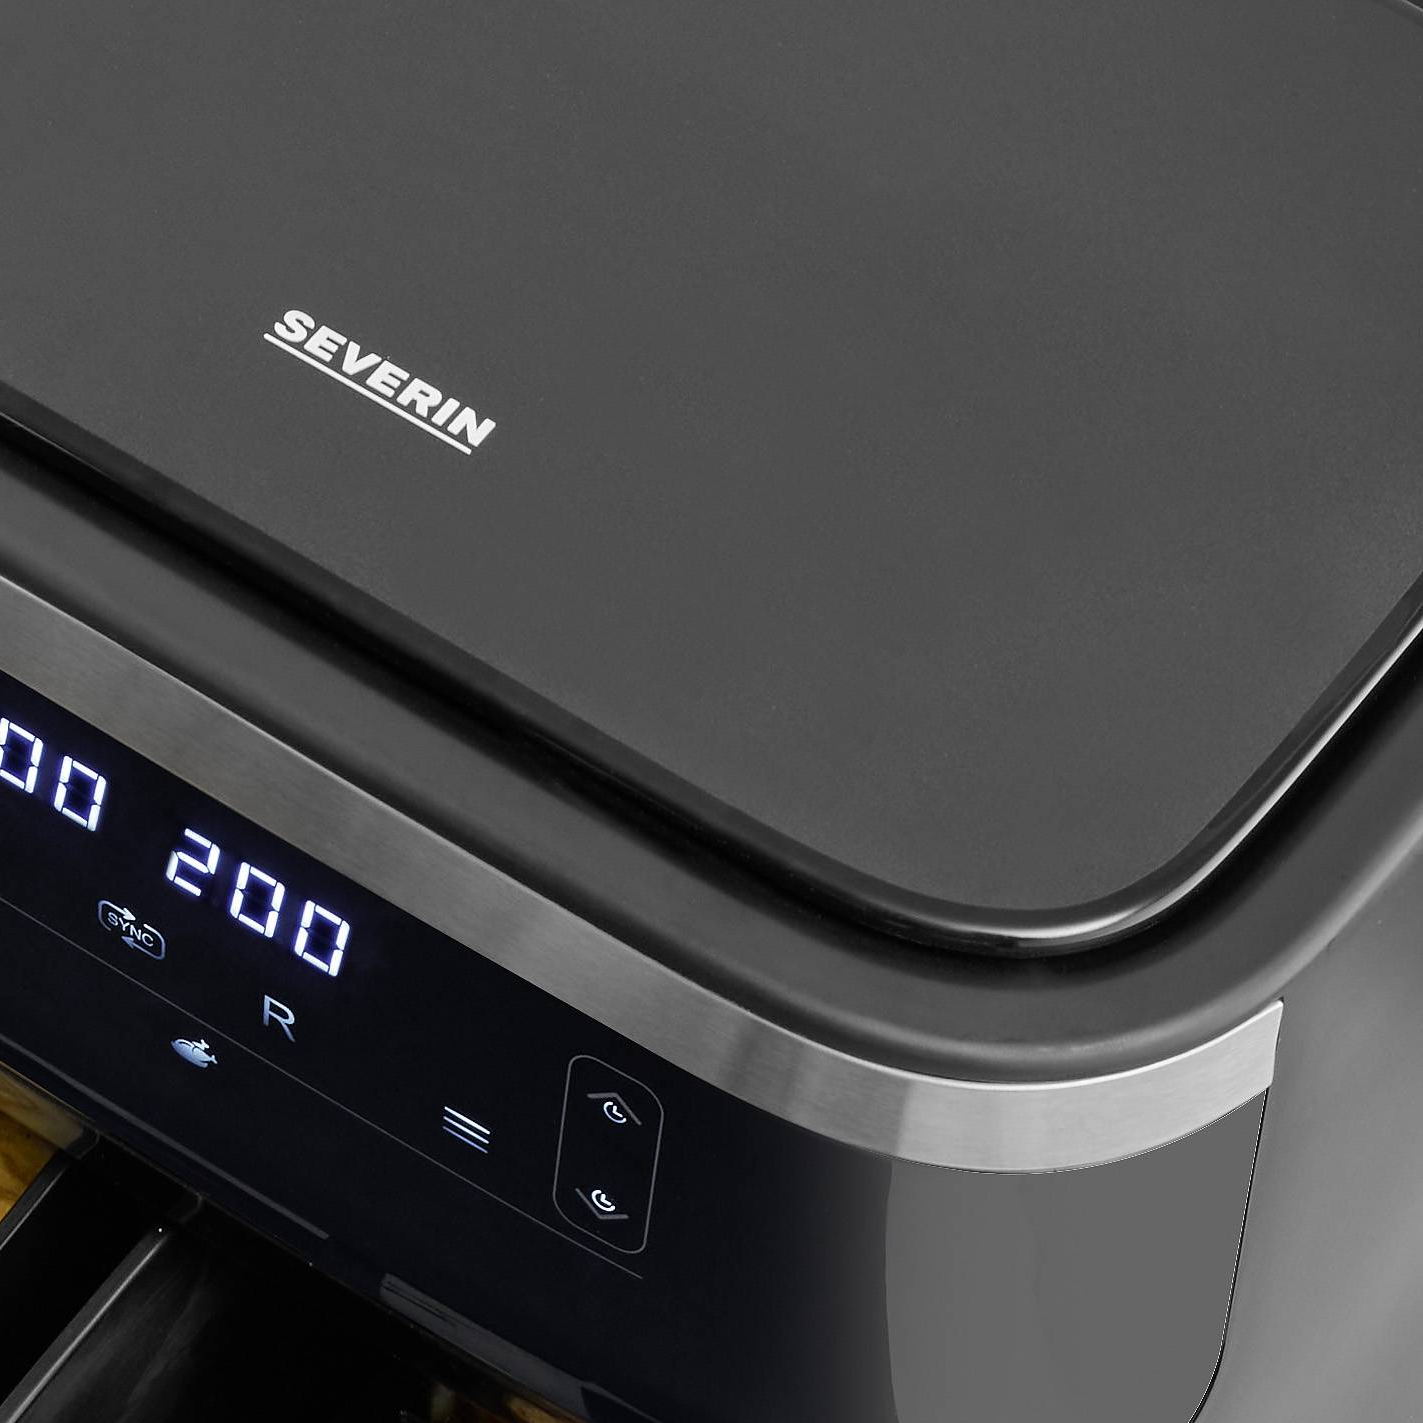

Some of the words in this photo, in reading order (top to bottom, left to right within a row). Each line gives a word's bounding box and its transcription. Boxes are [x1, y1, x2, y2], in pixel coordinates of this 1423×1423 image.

[273, 309, 497, 448] SEVERIN
[107, 911, 155, 948] SYNC
[165, 827, 351, 977] 200
[262, 994, 296, 1043] R
